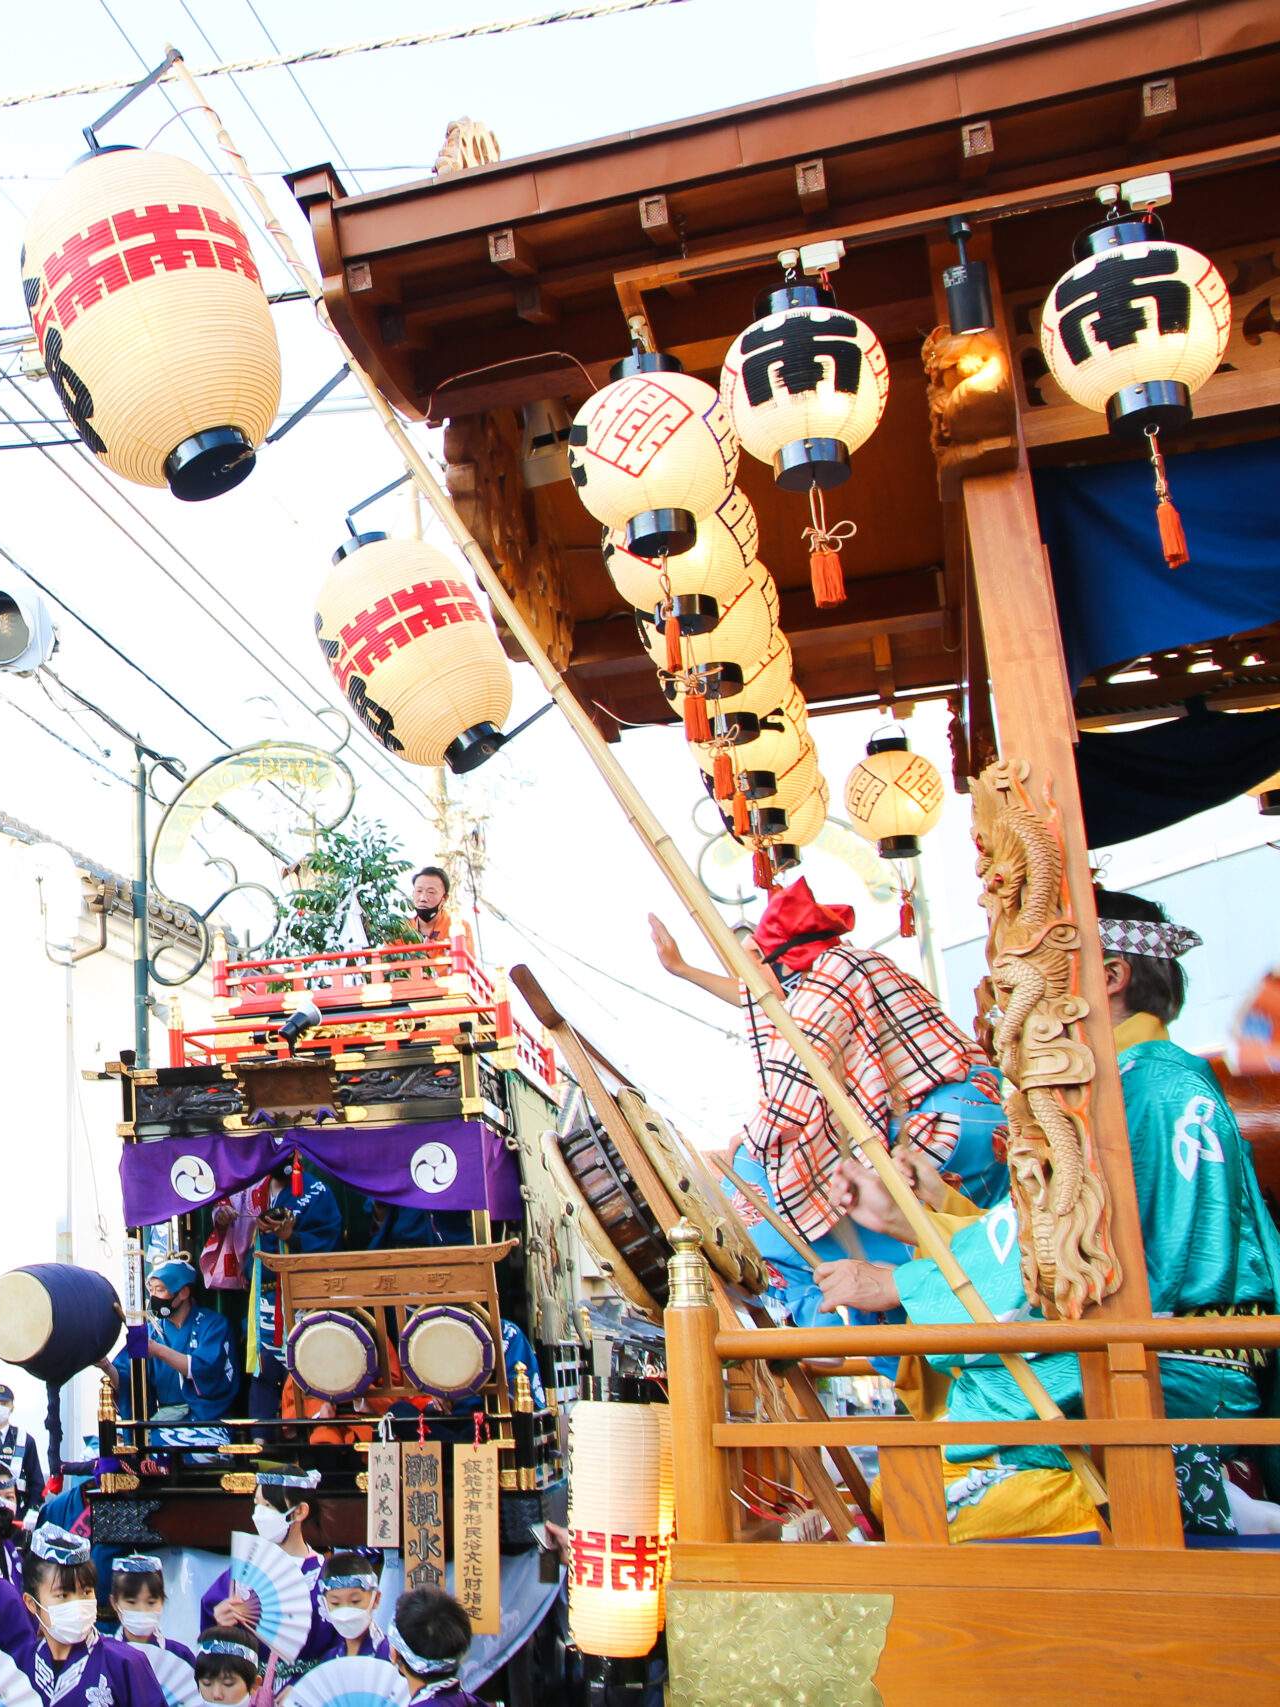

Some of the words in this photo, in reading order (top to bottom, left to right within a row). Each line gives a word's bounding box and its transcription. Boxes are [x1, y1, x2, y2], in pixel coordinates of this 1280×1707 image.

[323, 1271, 452, 1293] 河原町
[461, 1459, 483, 1621] 飯能市有形民俗文化財指定
